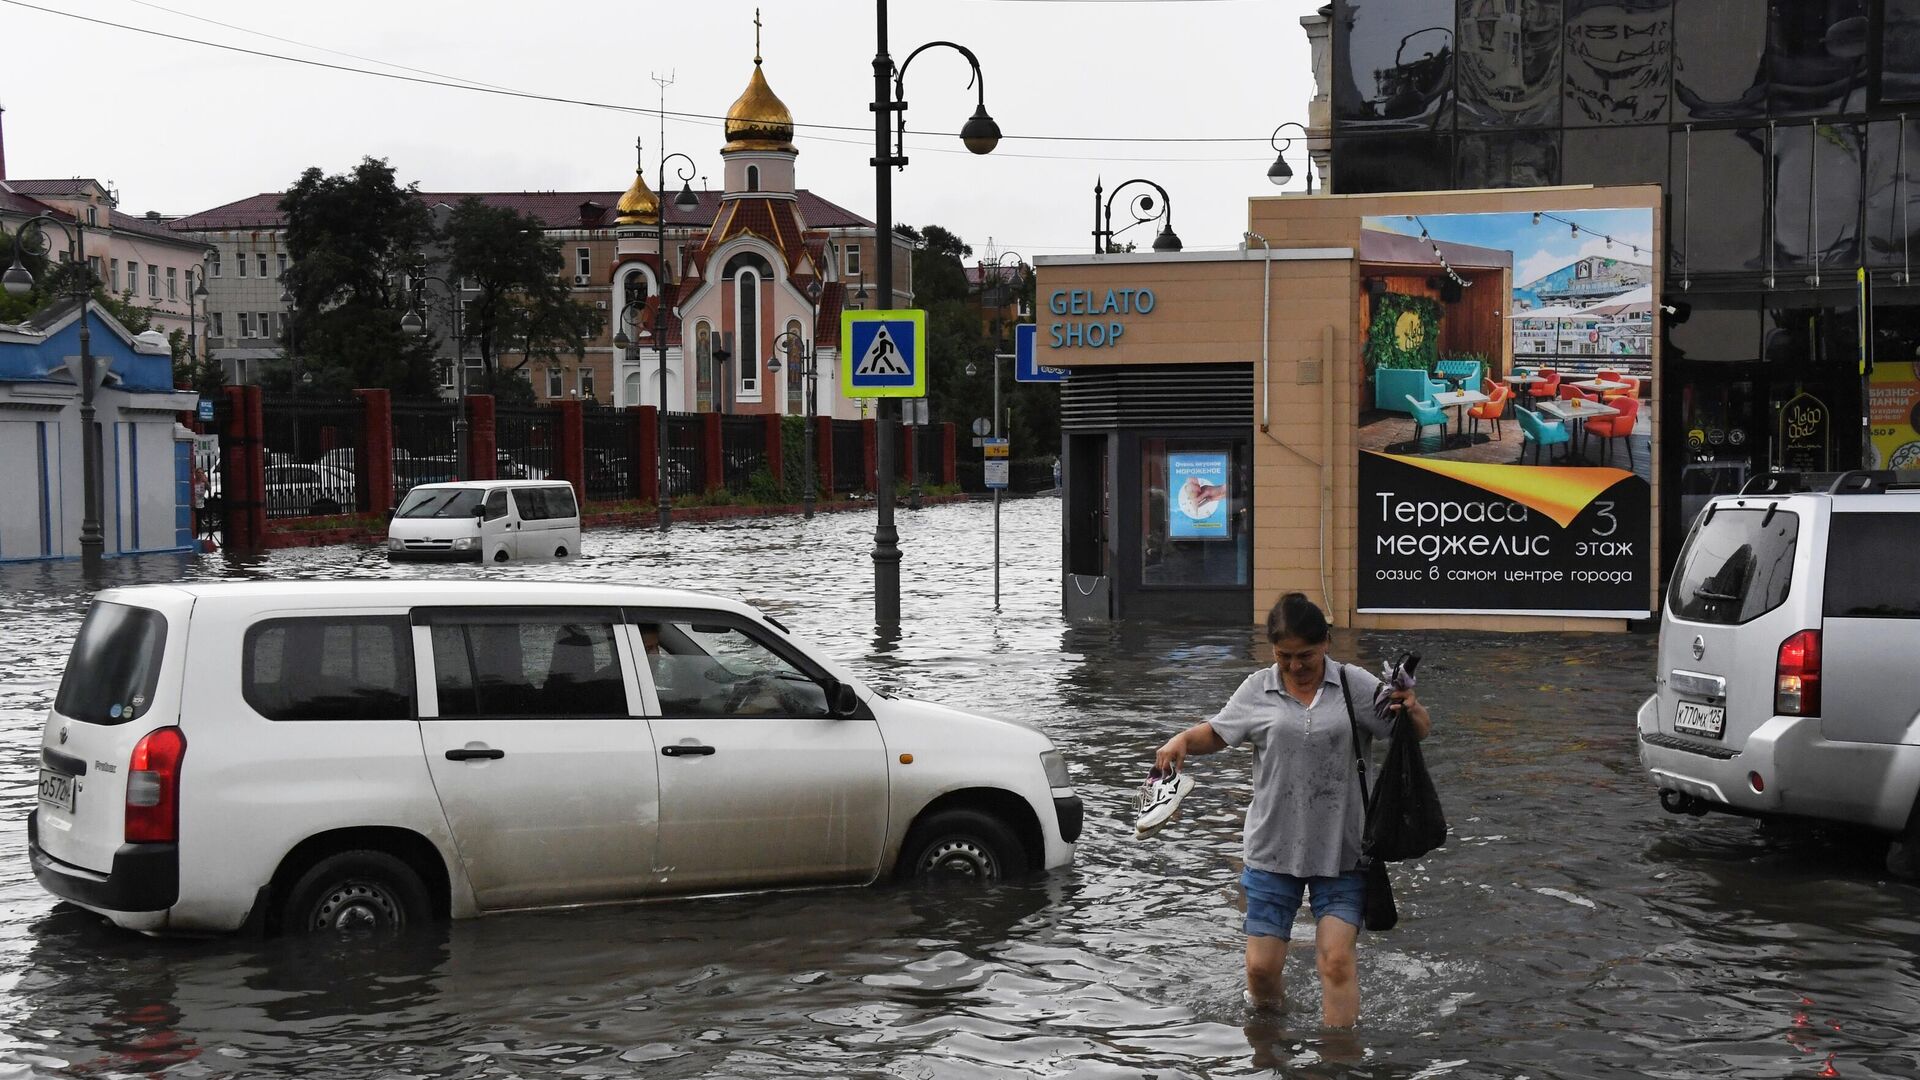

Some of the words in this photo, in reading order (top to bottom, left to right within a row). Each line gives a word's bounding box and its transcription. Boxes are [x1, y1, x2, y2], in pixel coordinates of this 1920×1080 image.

[1049, 287, 1156, 316] GELATO
[1050, 320, 1125, 349] SHOP
[1376, 492, 1528, 529] Терраса
[1591, 501, 1617, 537] 3
[1376, 535, 1550, 562] меджелис
[1575, 542, 1633, 556] этаж
[1375, 569, 1422, 581] оазис
[1429, 566, 1440, 581] в
[1446, 570, 1497, 581] самом
[1504, 570, 1564, 584] центре
[1571, 570, 1633, 585] города
[1710, 709, 1722, 724] 125
